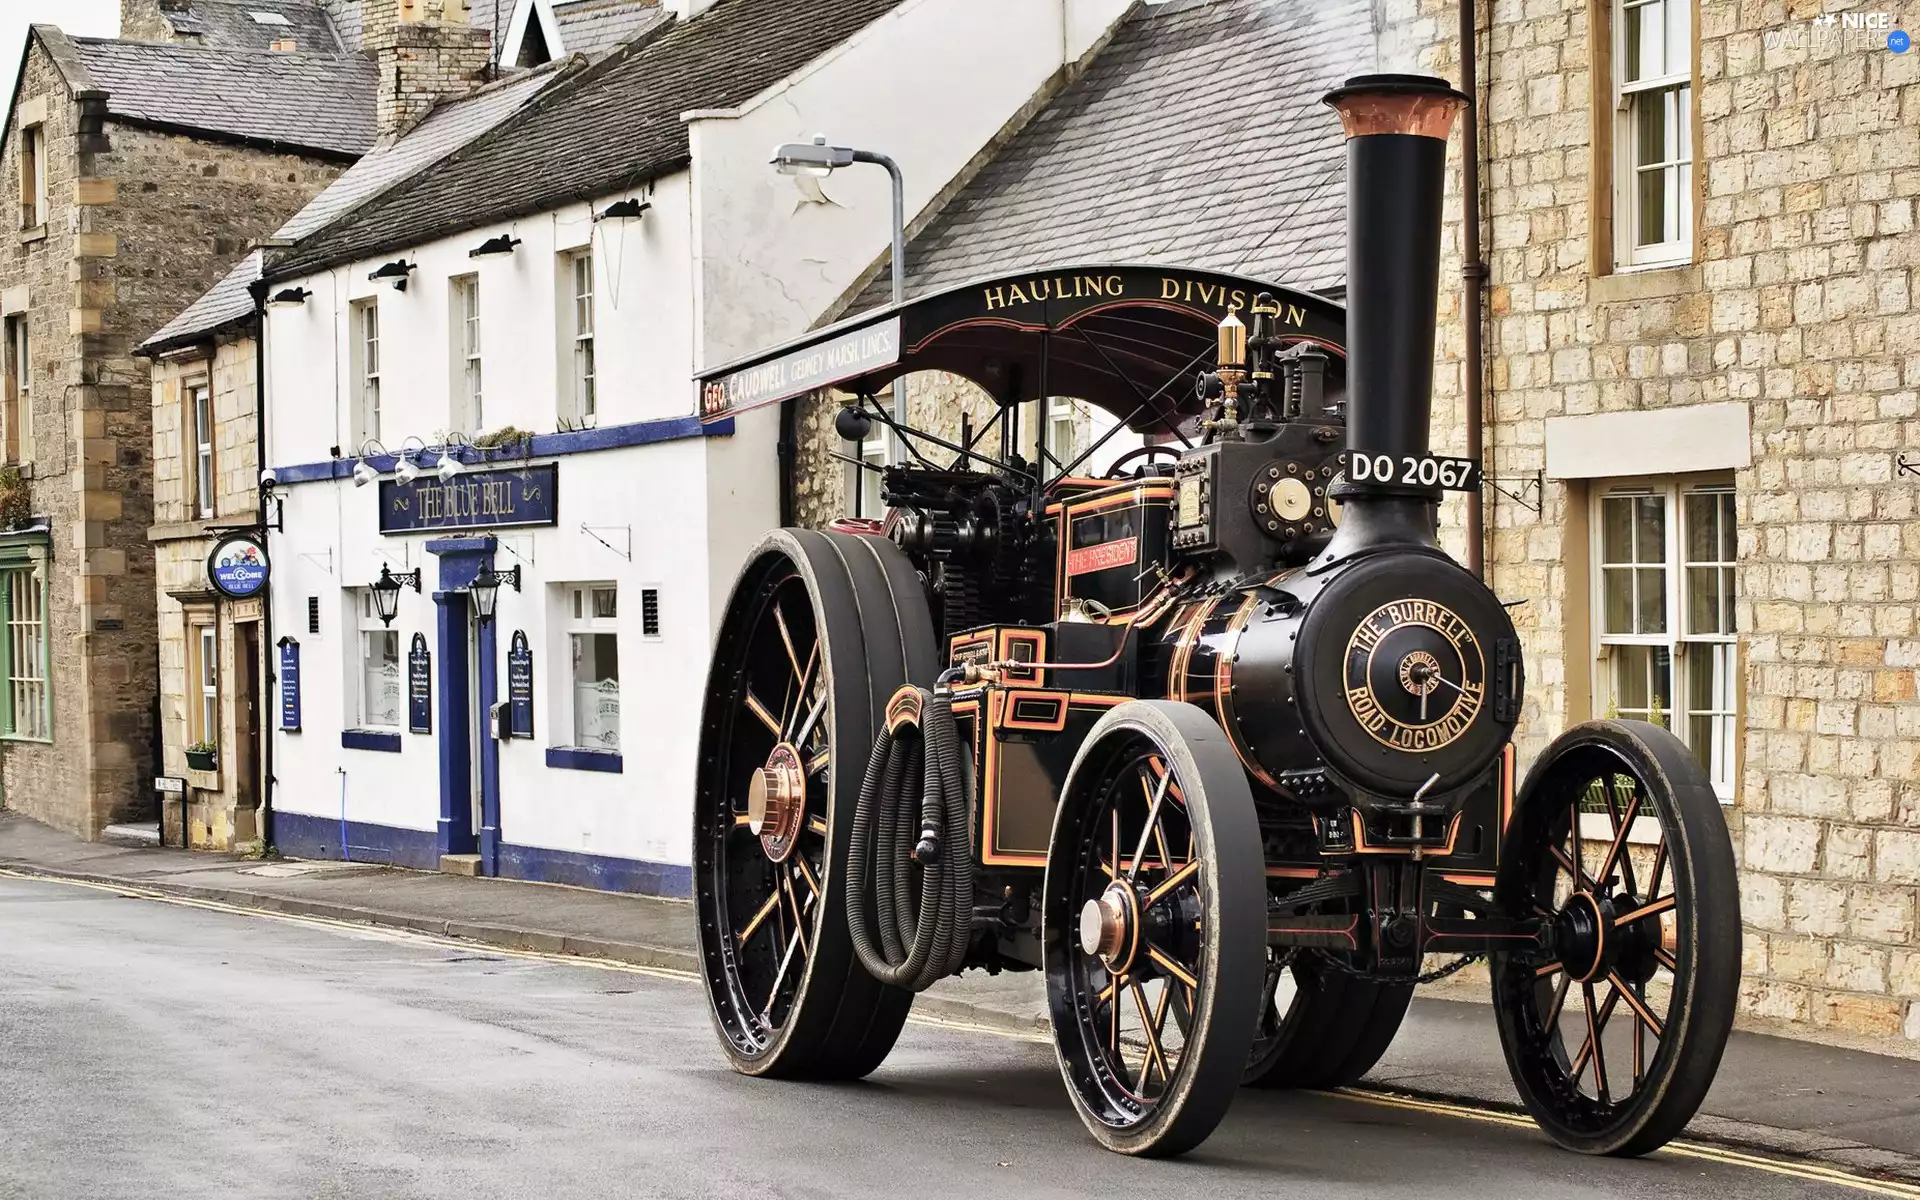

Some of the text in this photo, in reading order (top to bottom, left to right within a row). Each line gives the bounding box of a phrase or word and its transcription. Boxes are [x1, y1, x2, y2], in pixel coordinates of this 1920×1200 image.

[984, 275, 1124, 311] HAULING
[729, 363, 787, 401] CAUDWELL
[791, 351, 824, 381] GEDNEY
[861, 330, 892, 359] LINCS.
[1352, 453, 1472, 488] DO 2067
[416, 480, 516, 520] THE BLUE BELL
[220, 569, 262, 580] WELCOME
[1351, 617, 1386, 653] THE
[1349, 680, 1483, 749] ROAD LOCOMOTIVE
